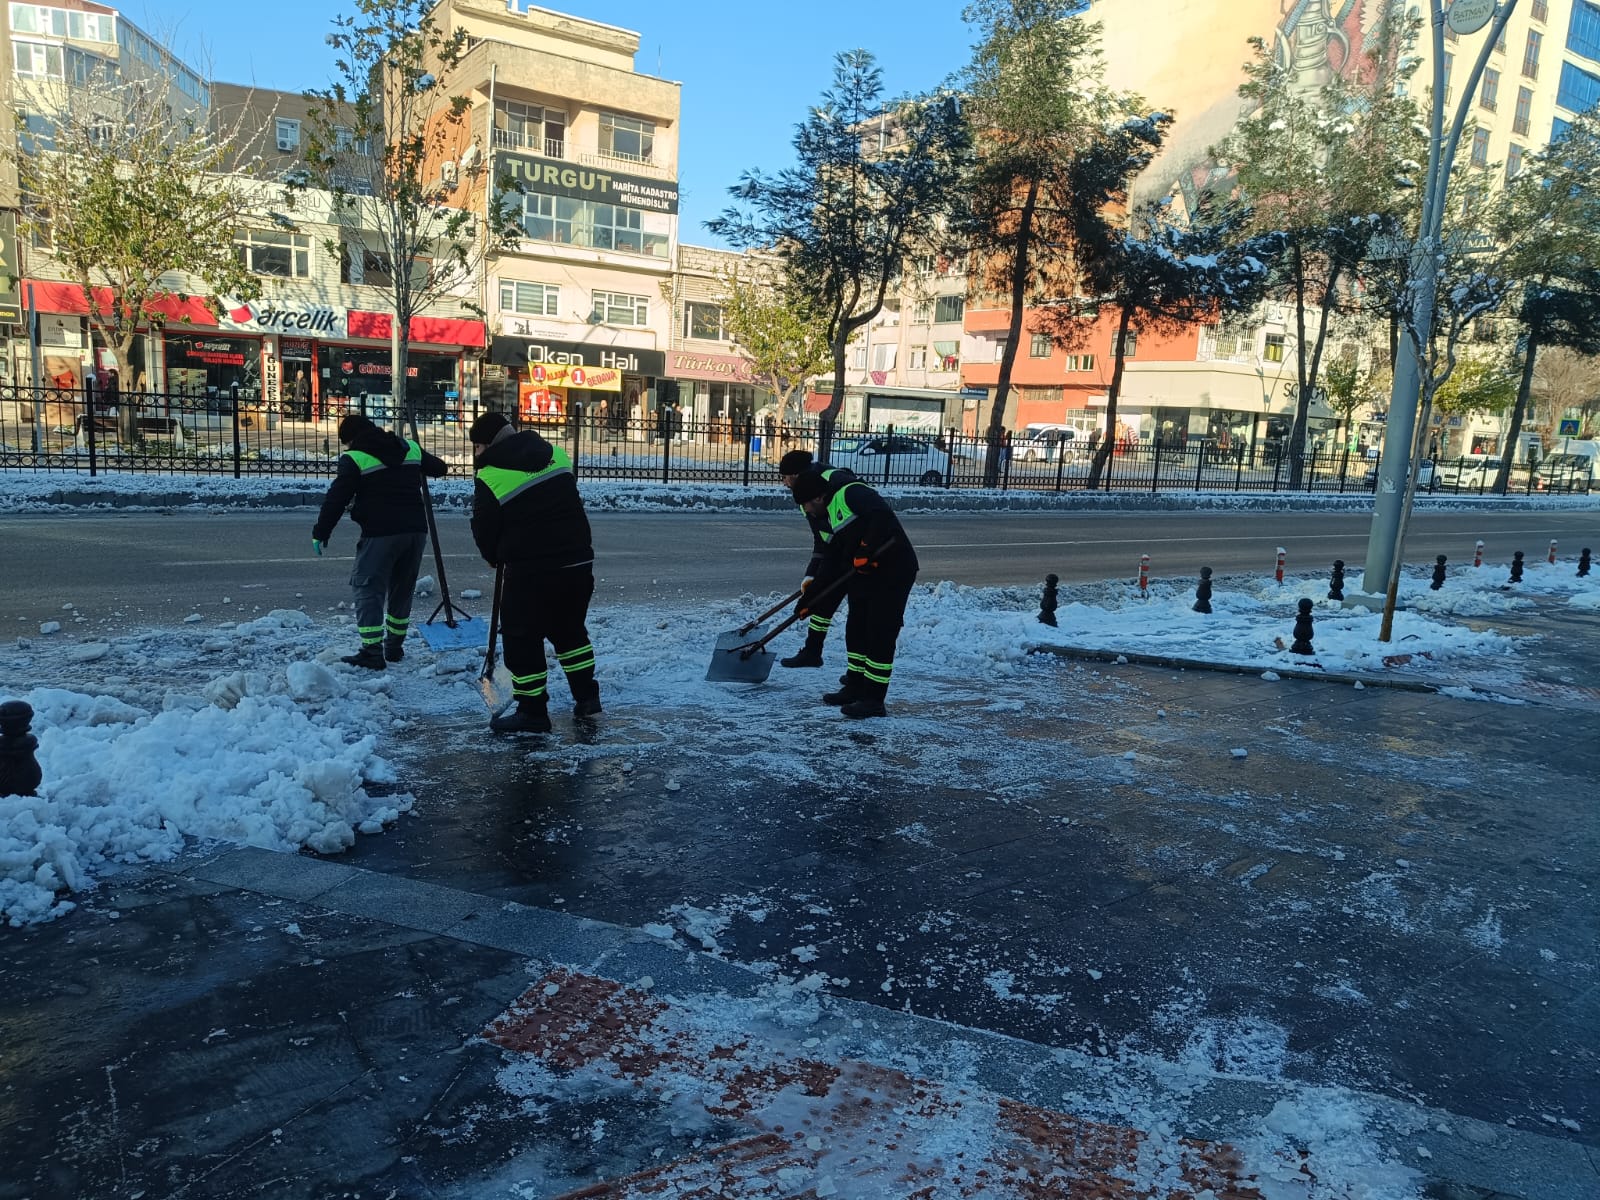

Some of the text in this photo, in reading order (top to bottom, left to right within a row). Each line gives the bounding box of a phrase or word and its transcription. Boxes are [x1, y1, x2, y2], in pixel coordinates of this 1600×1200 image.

[1453, 4, 1489, 20] BATMAN
[506, 158, 677, 200] TURGUT HARİTA KADASTRO
[620, 194, 669, 210] MÜHENDİSLİK
[257, 309, 338, 332] arçelik
[527, 344, 584, 366] Okan
[673, 354, 736, 374] Türkay
[573, 370, 583, 384] 1
[586, 370, 618, 387] BEDAVA
